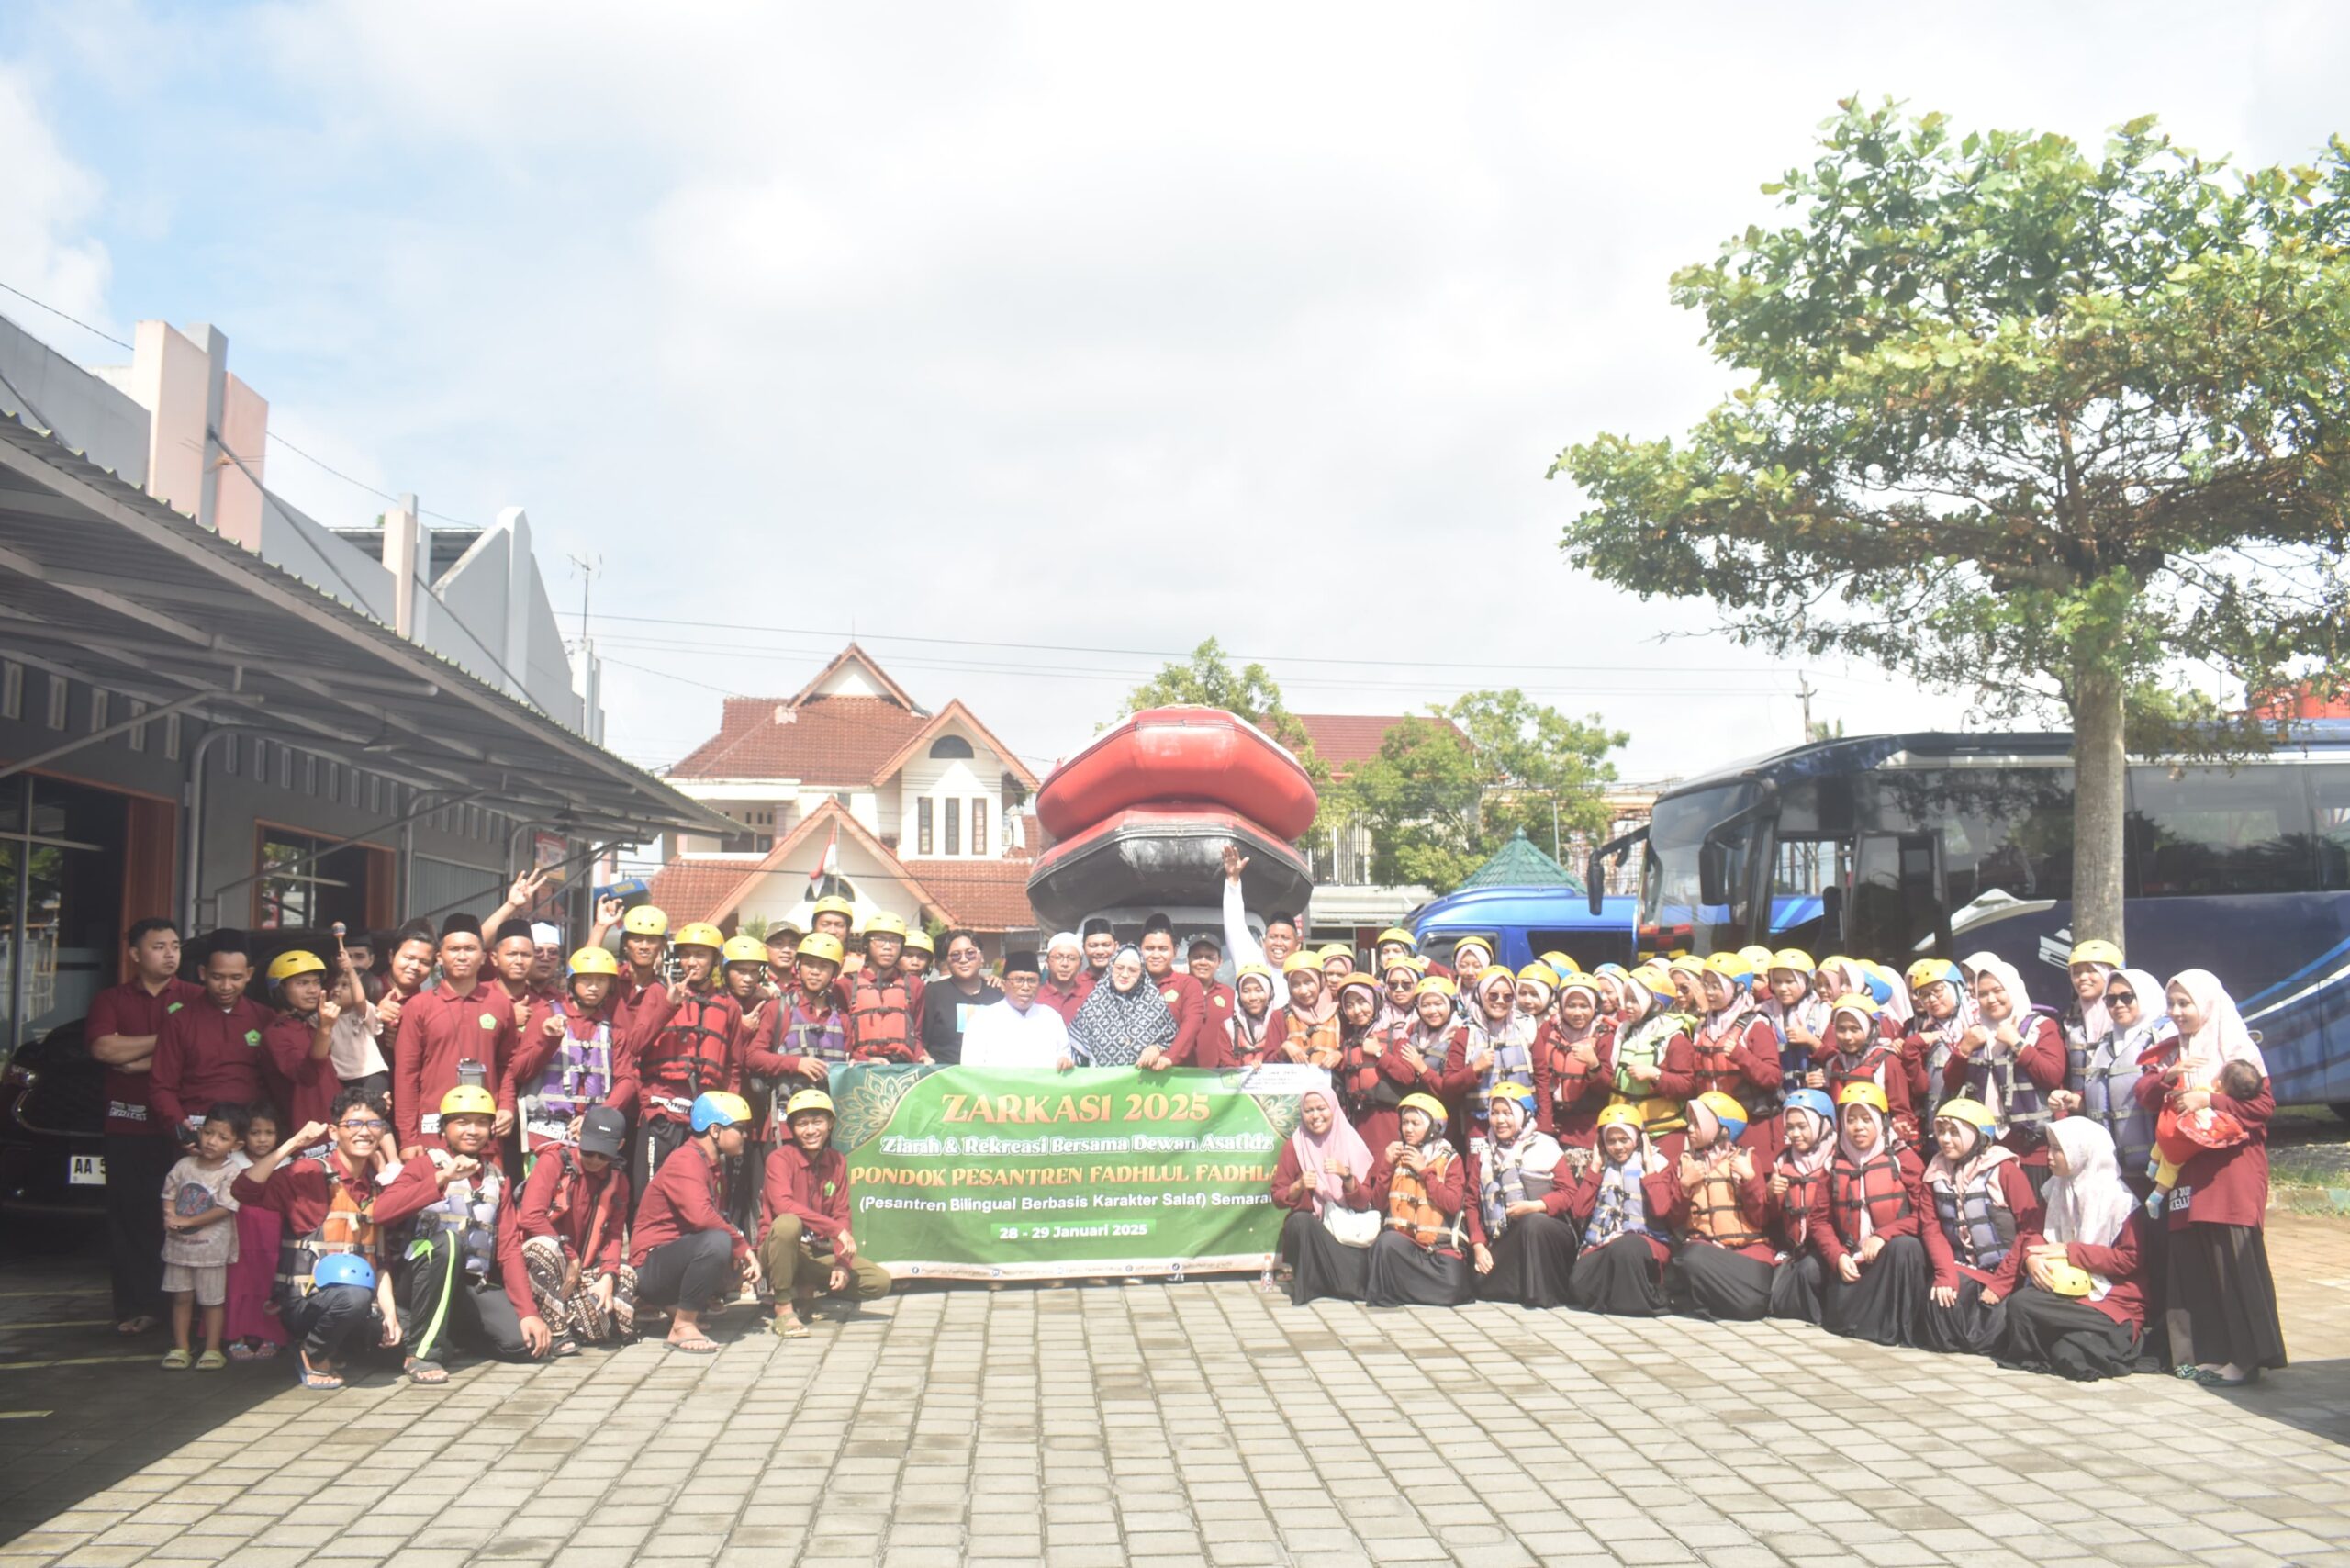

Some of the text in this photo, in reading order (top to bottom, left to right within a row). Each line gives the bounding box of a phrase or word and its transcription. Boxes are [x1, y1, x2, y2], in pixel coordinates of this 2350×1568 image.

[941, 1092, 1210, 1124] ZARKASI 2025
[880, 1132, 1274, 1156] Ziarah & Rekreasi Bersama Dewan Asatidz
[74, 1159, 92, 1174] AA
[850, 1166, 946, 1187] PONDOK
[952, 1167, 1082, 1186] PESANTREN
[1090, 1164, 1190, 1183] FADHLUL
[859, 1193, 1272, 1213] (Pesantren Bilingual Berbasis Karakter Salaf) Semara
[999, 1227, 1019, 1239] 28
[1032, 1226, 1050, 1238] 29
[1053, 1224, 1109, 1238] Januari
[1112, 1223, 1147, 1236] 2025
